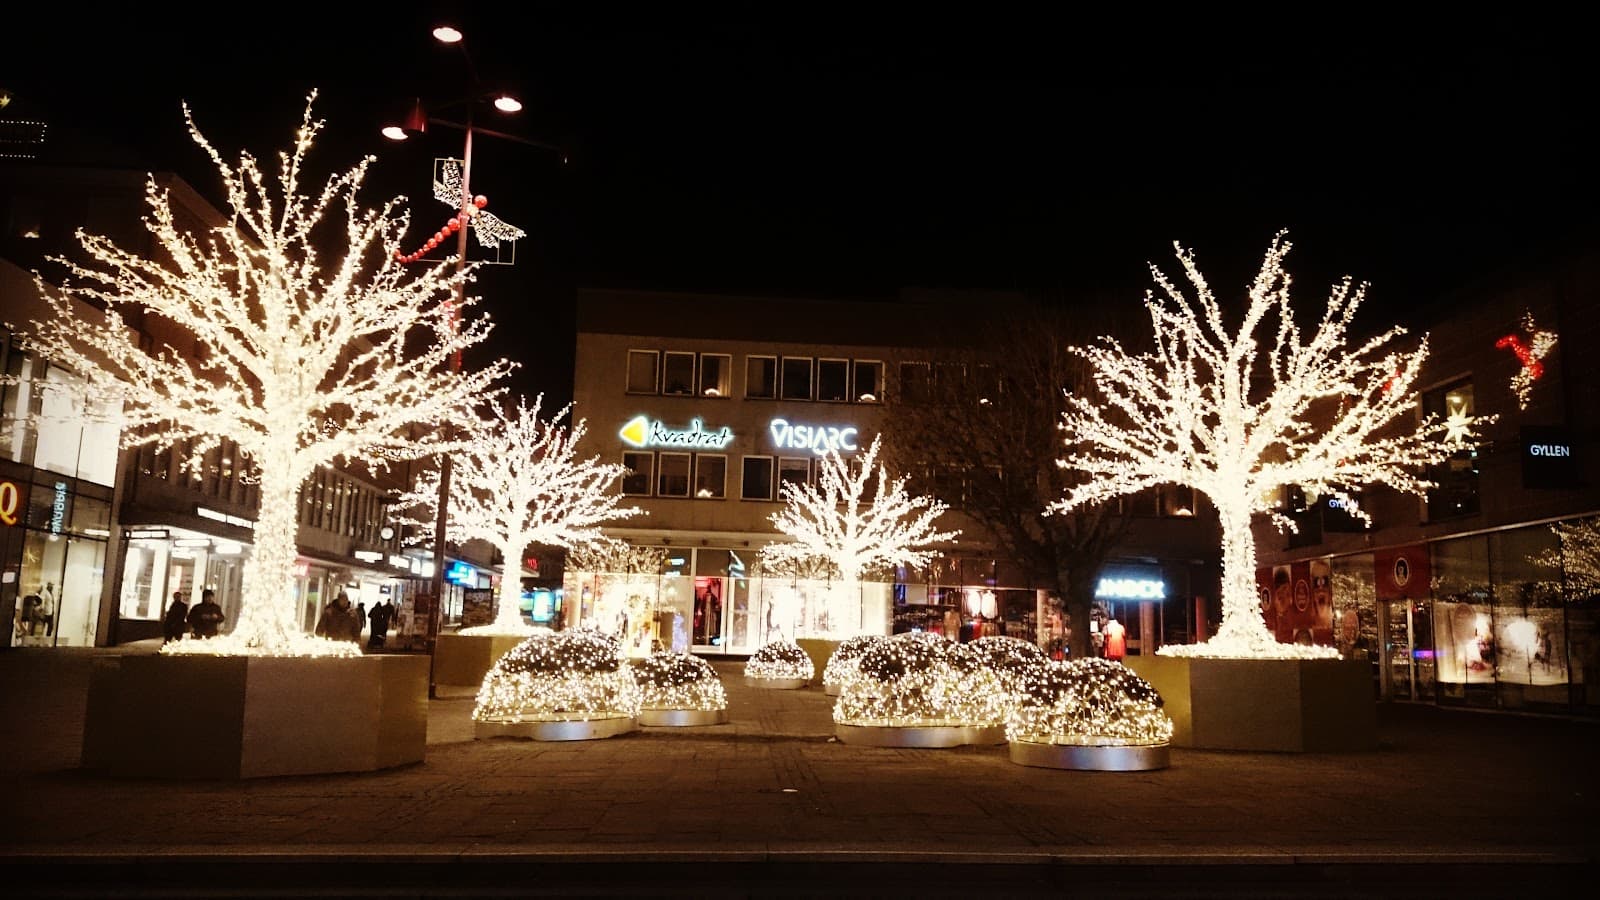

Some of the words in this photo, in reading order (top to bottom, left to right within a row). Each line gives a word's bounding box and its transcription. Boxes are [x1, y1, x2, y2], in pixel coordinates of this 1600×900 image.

[650, 418, 732, 446] kvadrat
[770, 418, 858, 455] VISIARC
[1530, 444, 1570, 457] GYLLEN
